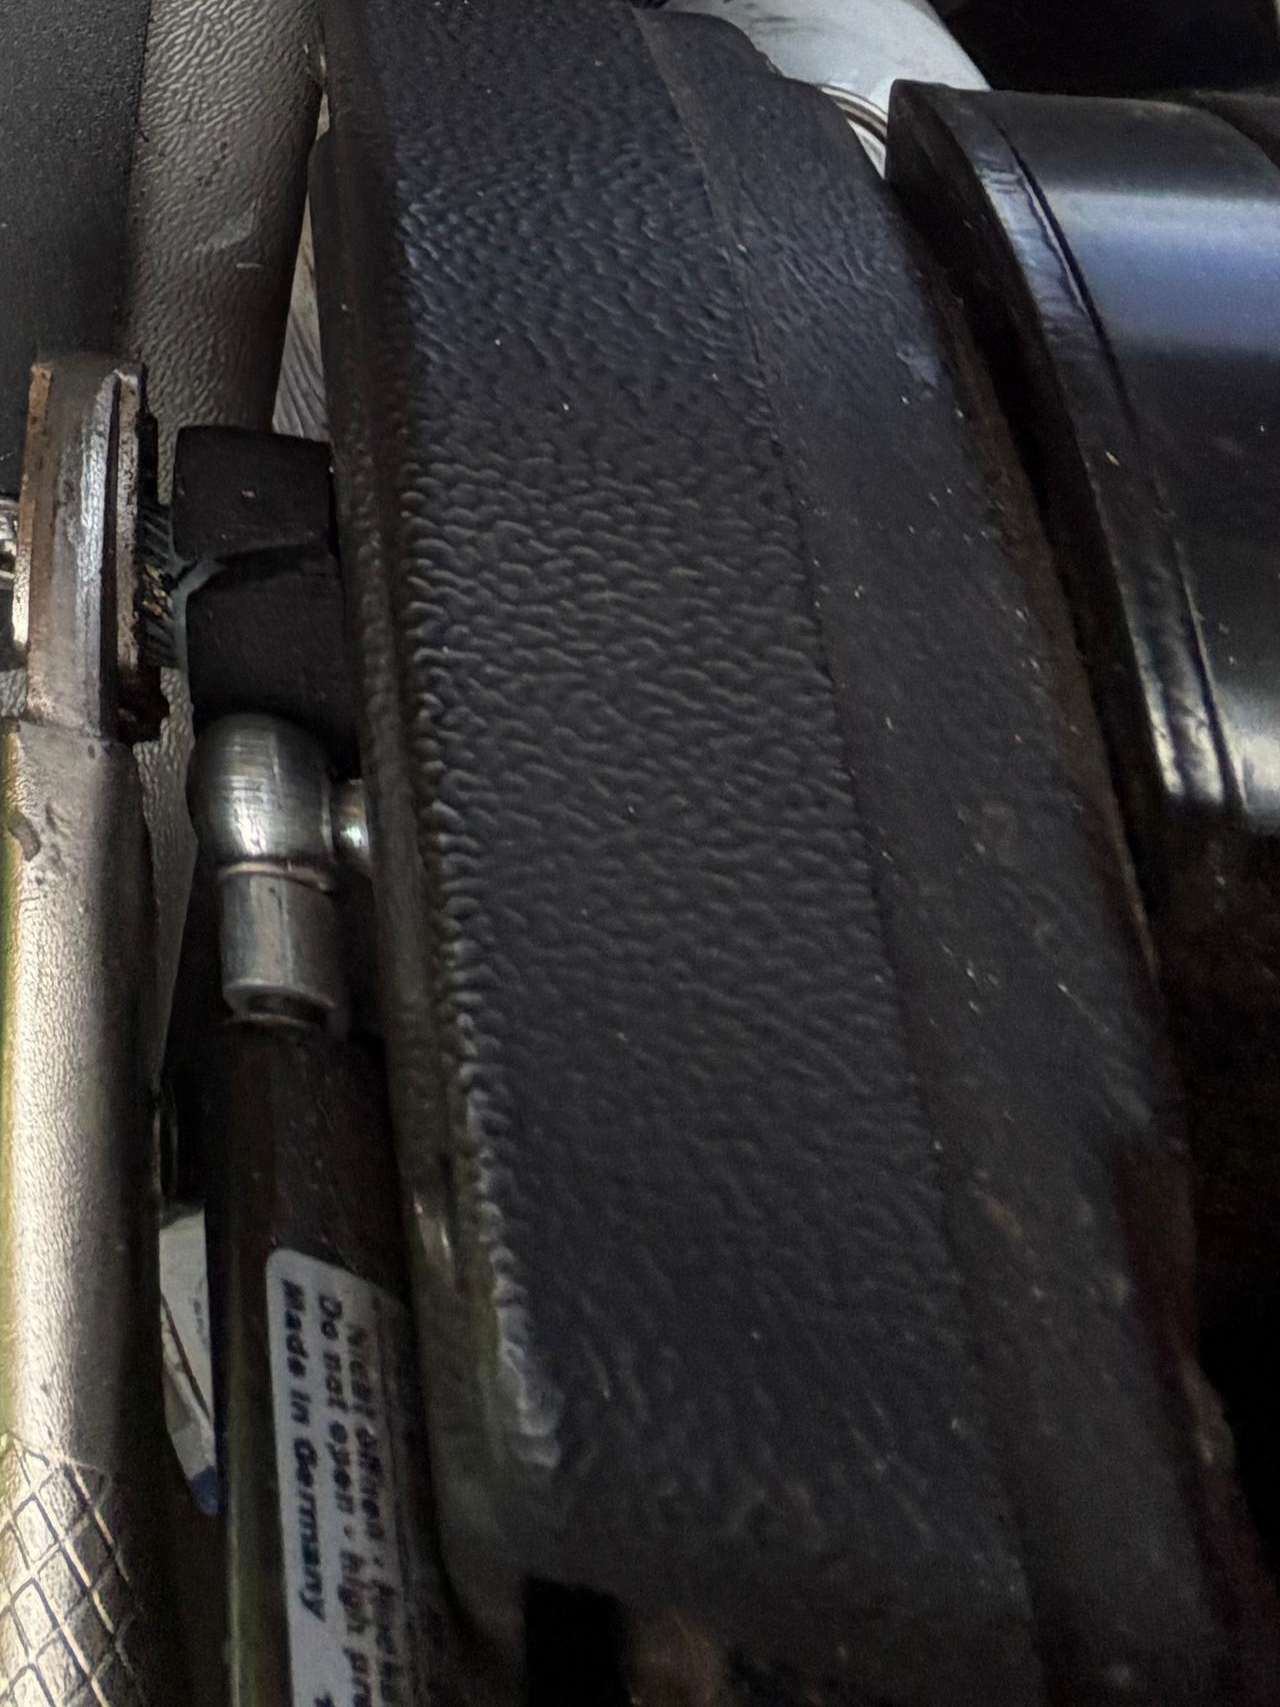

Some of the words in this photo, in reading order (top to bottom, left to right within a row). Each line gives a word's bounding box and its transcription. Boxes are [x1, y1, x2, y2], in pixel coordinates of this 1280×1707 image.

[280, 1279, 308, 1377] Made
[289, 1390, 311, 1425] in
[322, 1351, 348, 1414] not
[293, 1439, 326, 1622] Germany
